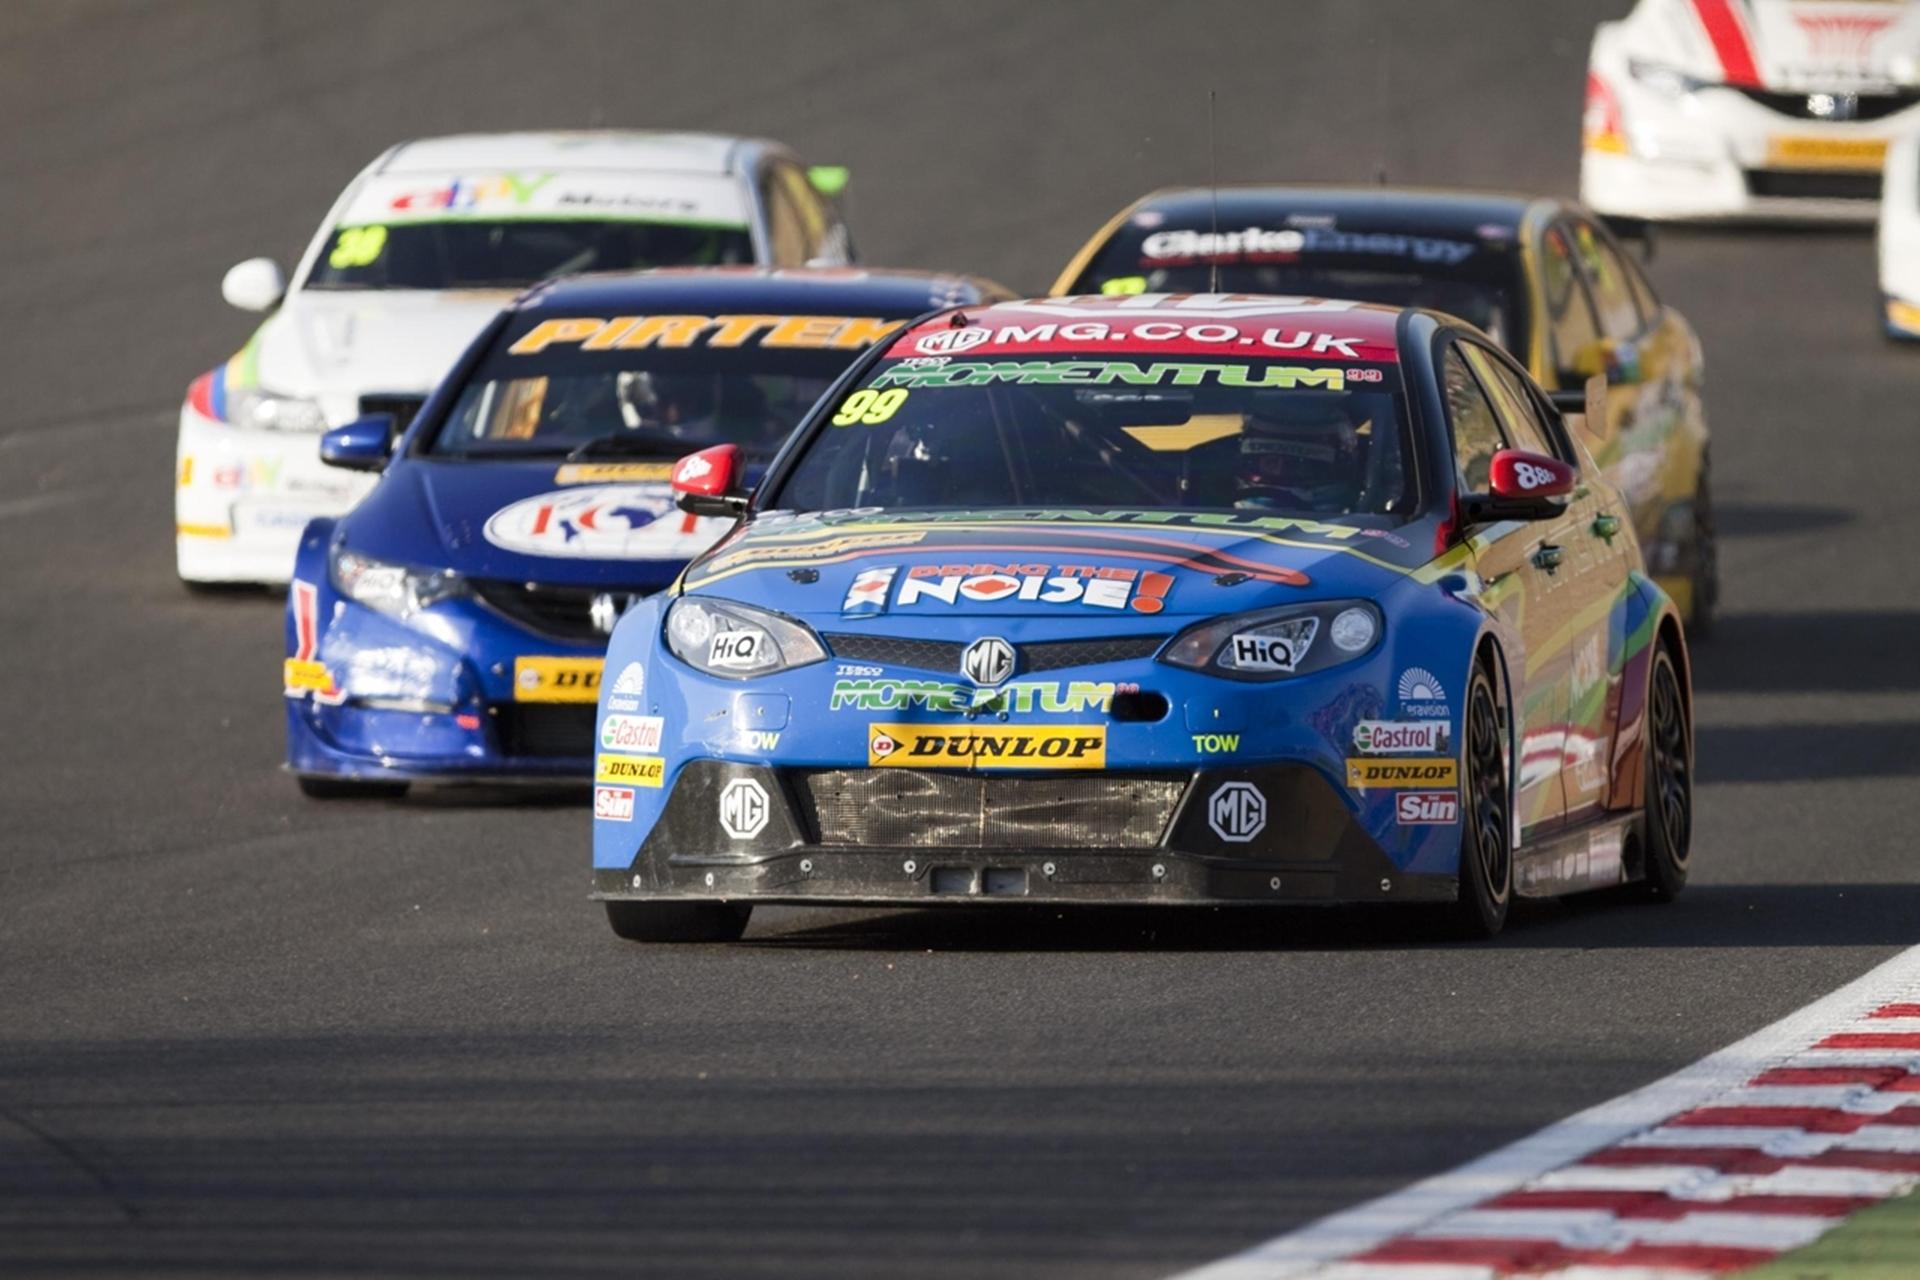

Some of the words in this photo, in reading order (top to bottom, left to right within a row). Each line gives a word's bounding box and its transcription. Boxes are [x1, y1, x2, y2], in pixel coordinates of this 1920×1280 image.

[1141, 228, 1305, 260] Clarke
[1305, 227, 1478, 264] Energy
[918, 329, 990, 355] MG
[994, 322, 1367, 358] MG.CO.UK
[868, 361, 1344, 391] MOMENTUM
[832, 388, 909, 427] 99
[1057, 565, 1138, 582] THE
[711, 635, 756, 661] HiQ
[965, 639, 1014, 684] MG
[1236, 640, 1293, 667] HiQ
[830, 679, 1117, 713] MOMENTUM
[614, 719, 659, 747] Castrol
[908, 735, 1103, 758] DUNLOP
[1192, 734, 1240, 753] TOW
[1372, 725, 1432, 749] Castrol
[608, 761, 662, 779] DUNLOP
[1365, 765, 1453, 780] DUNLOP
[597, 789, 632, 818] Sun
[722, 782, 766, 835] MG
[1212, 785, 1263, 838] MG
[1400, 796, 1456, 820] Sun
